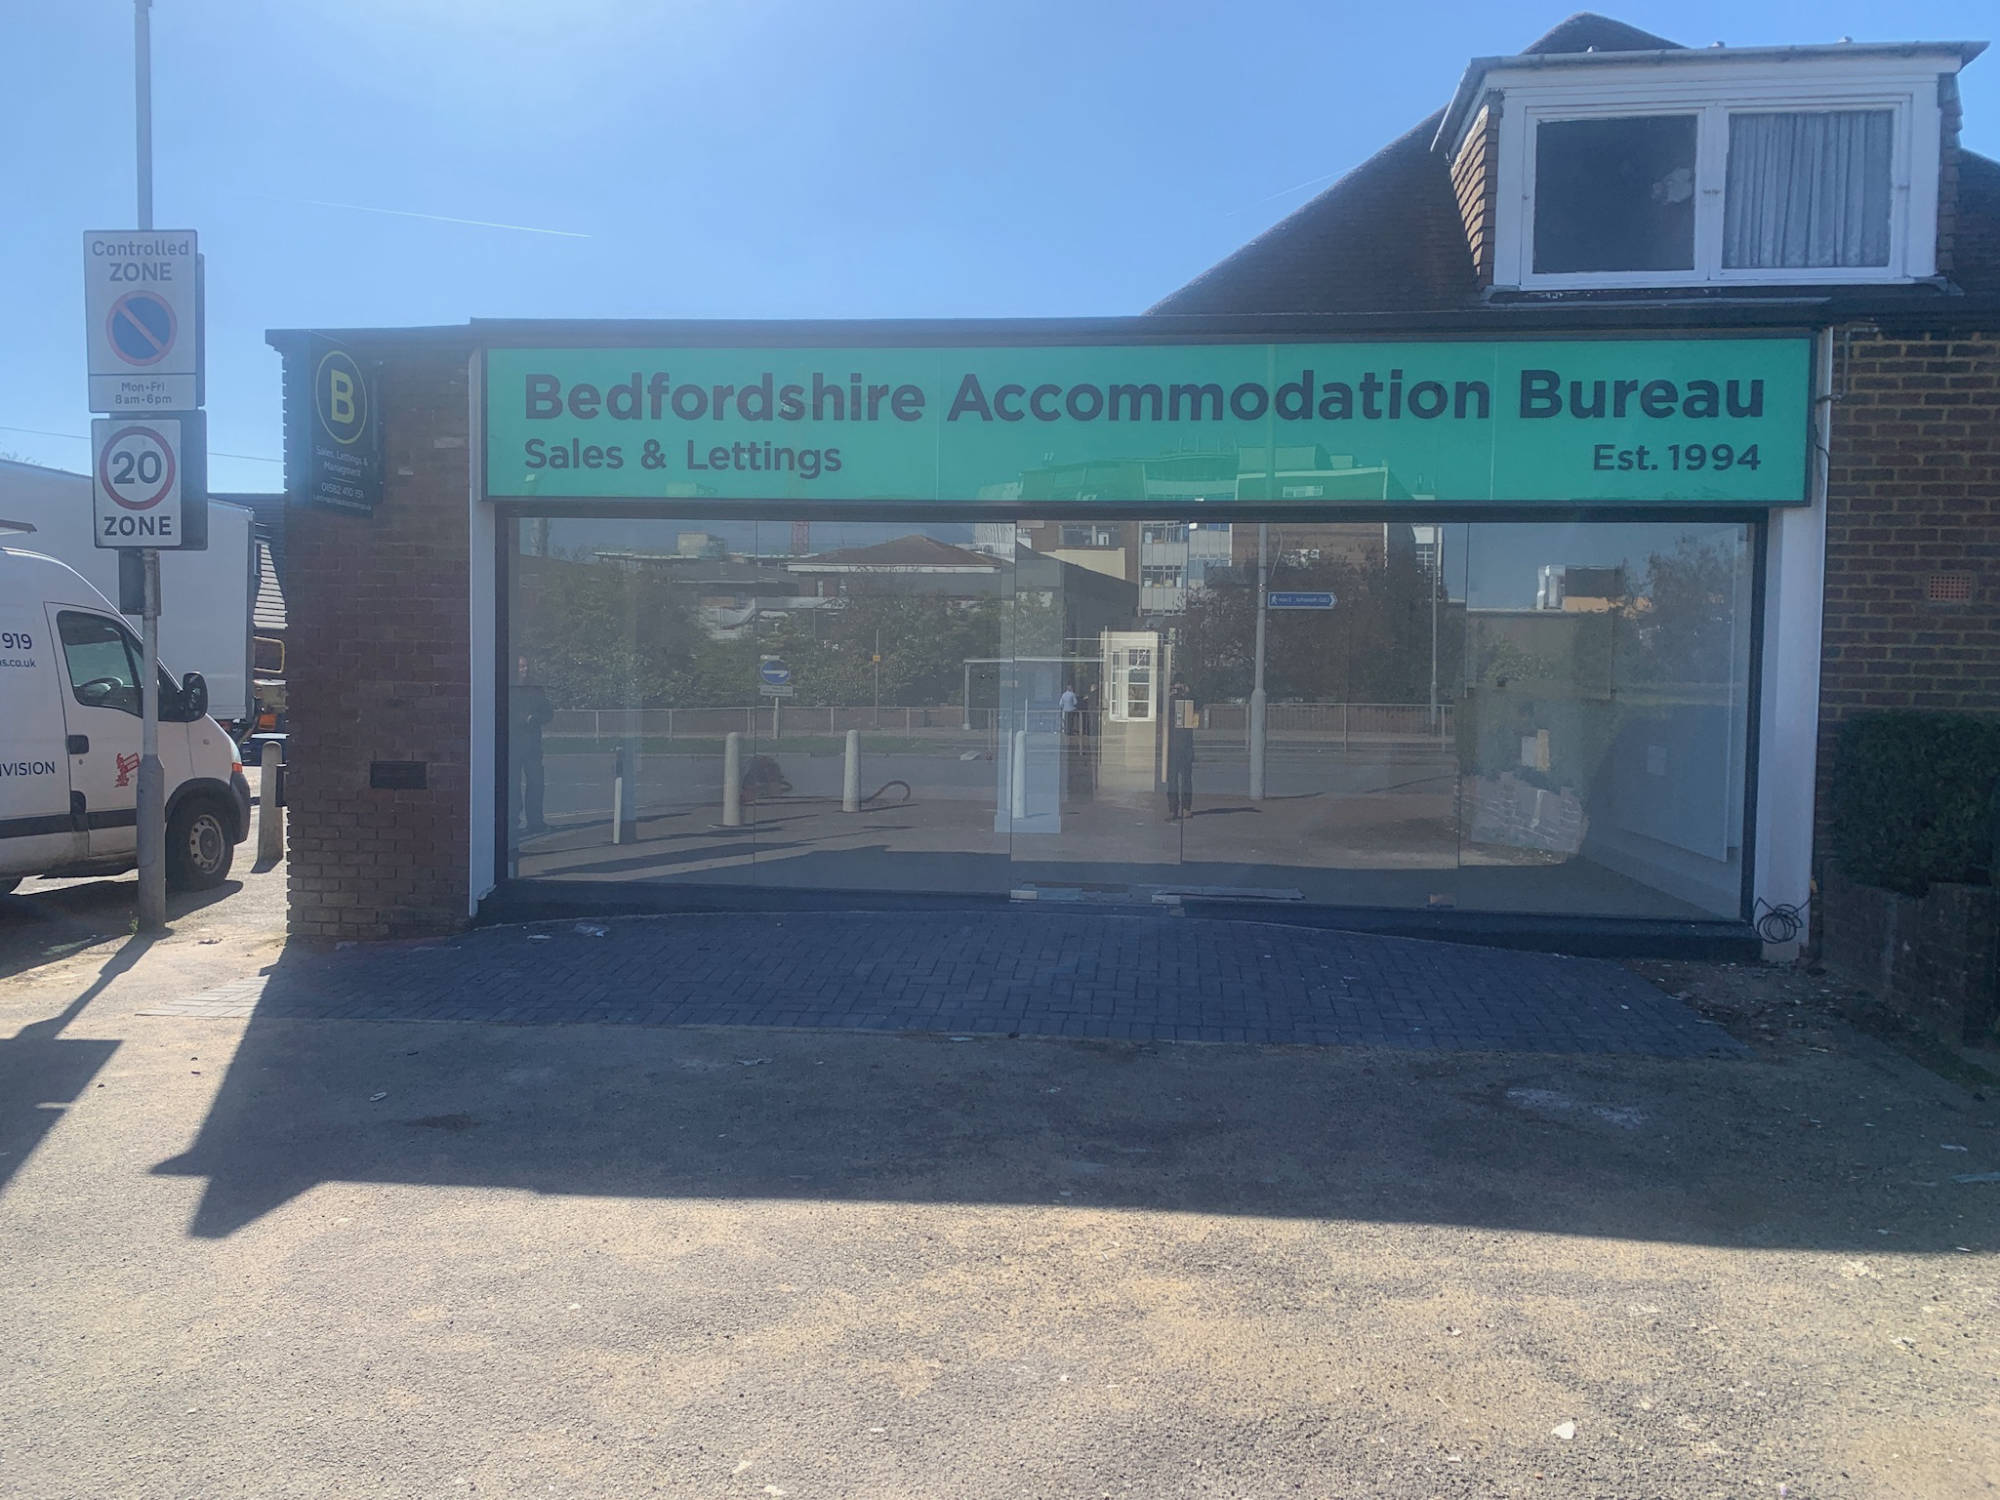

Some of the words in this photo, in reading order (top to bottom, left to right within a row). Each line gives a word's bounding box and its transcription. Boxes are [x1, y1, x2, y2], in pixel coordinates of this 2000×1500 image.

[92, 240, 189, 257] Controlled
[109, 262, 173, 282] ZONE
[331, 369, 355, 424] B
[526, 372, 926, 423] Bedfordshire
[947, 369, 1491, 422] Accommodation
[1519, 369, 1765, 419] Bureau
[112, 452, 162, 485] 20
[524, 438, 624, 470] Sales
[640, 439, 667, 470] &
[687, 440, 843, 480] Lettings
[1594, 444, 1659, 471] Est.
[1668, 444, 1762, 471] 1994
[104, 516, 172, 537] ZONE
[1, 632, 33, 650] 919
